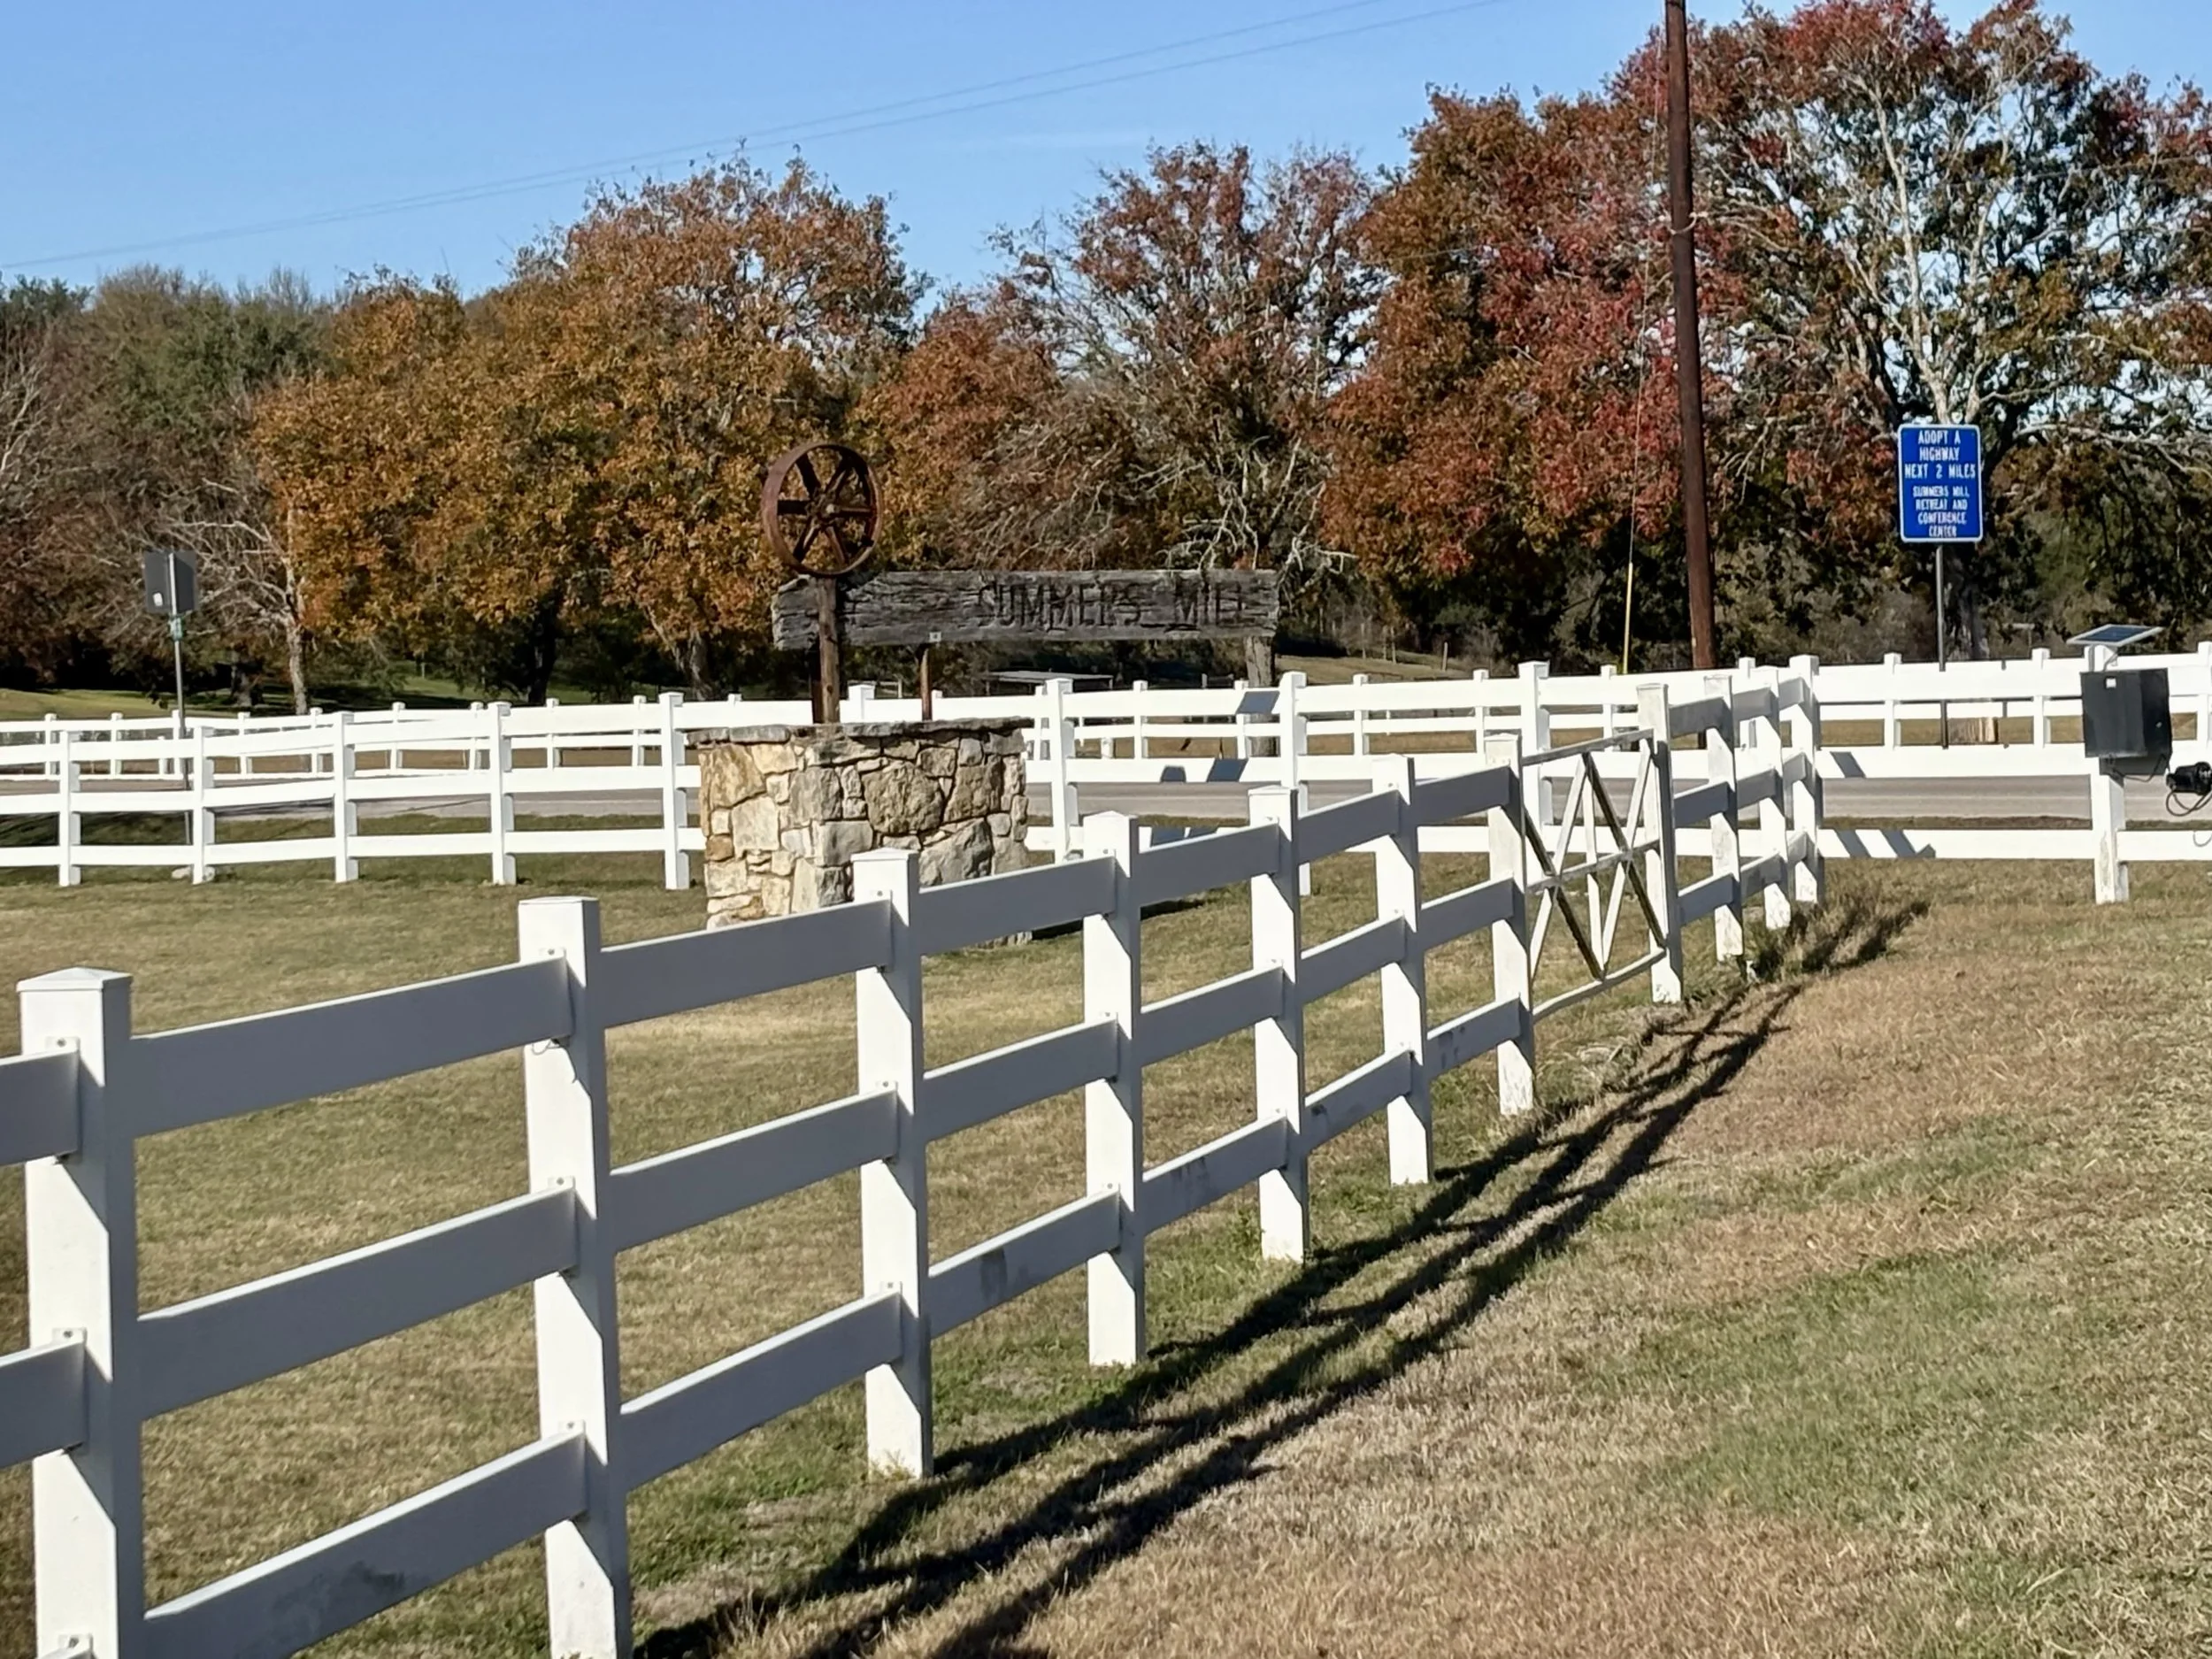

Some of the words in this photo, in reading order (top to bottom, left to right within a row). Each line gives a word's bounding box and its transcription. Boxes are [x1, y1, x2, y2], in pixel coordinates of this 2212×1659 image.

[1918, 430, 1948, 444] ADOPT
[1954, 430, 1962, 444] A
[1919, 447, 1960, 461] HIGHWAY
[1904, 464, 1928, 479] NEXT
[1936, 464, 1943, 479] 2
[1948, 464, 1976, 479] MILES
[1912, 485, 1949, 497] SUMMERS
[1952, 486, 1970, 497] MILL
[1952, 499, 1968, 511] AND
